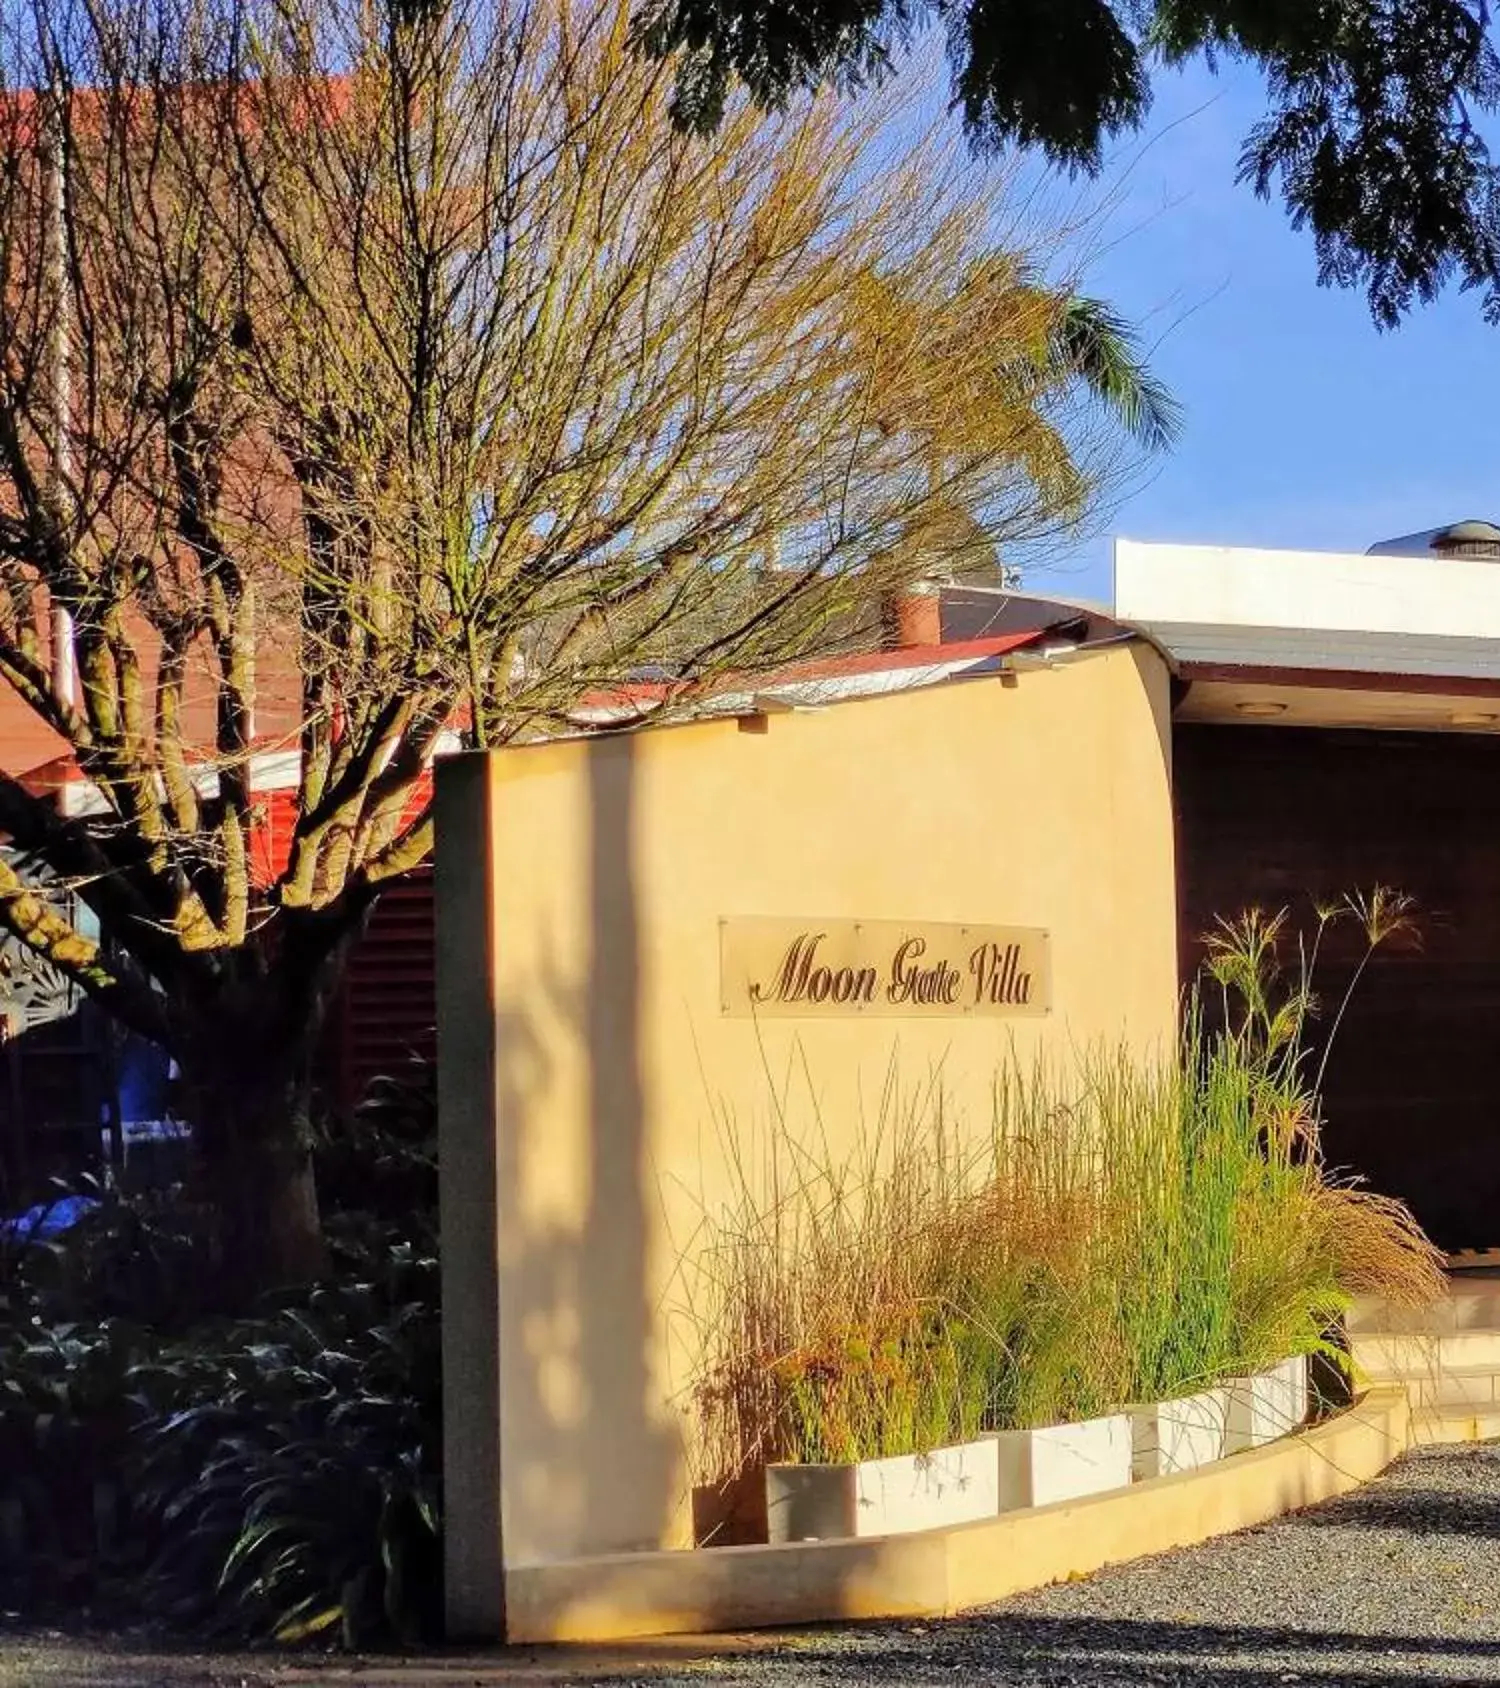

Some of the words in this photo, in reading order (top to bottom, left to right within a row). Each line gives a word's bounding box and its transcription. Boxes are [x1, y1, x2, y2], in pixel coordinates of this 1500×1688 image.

[750, 933, 877, 1004] Moon
[887, 937, 961, 1005] Gate
[969, 943, 1031, 1005] Villa
